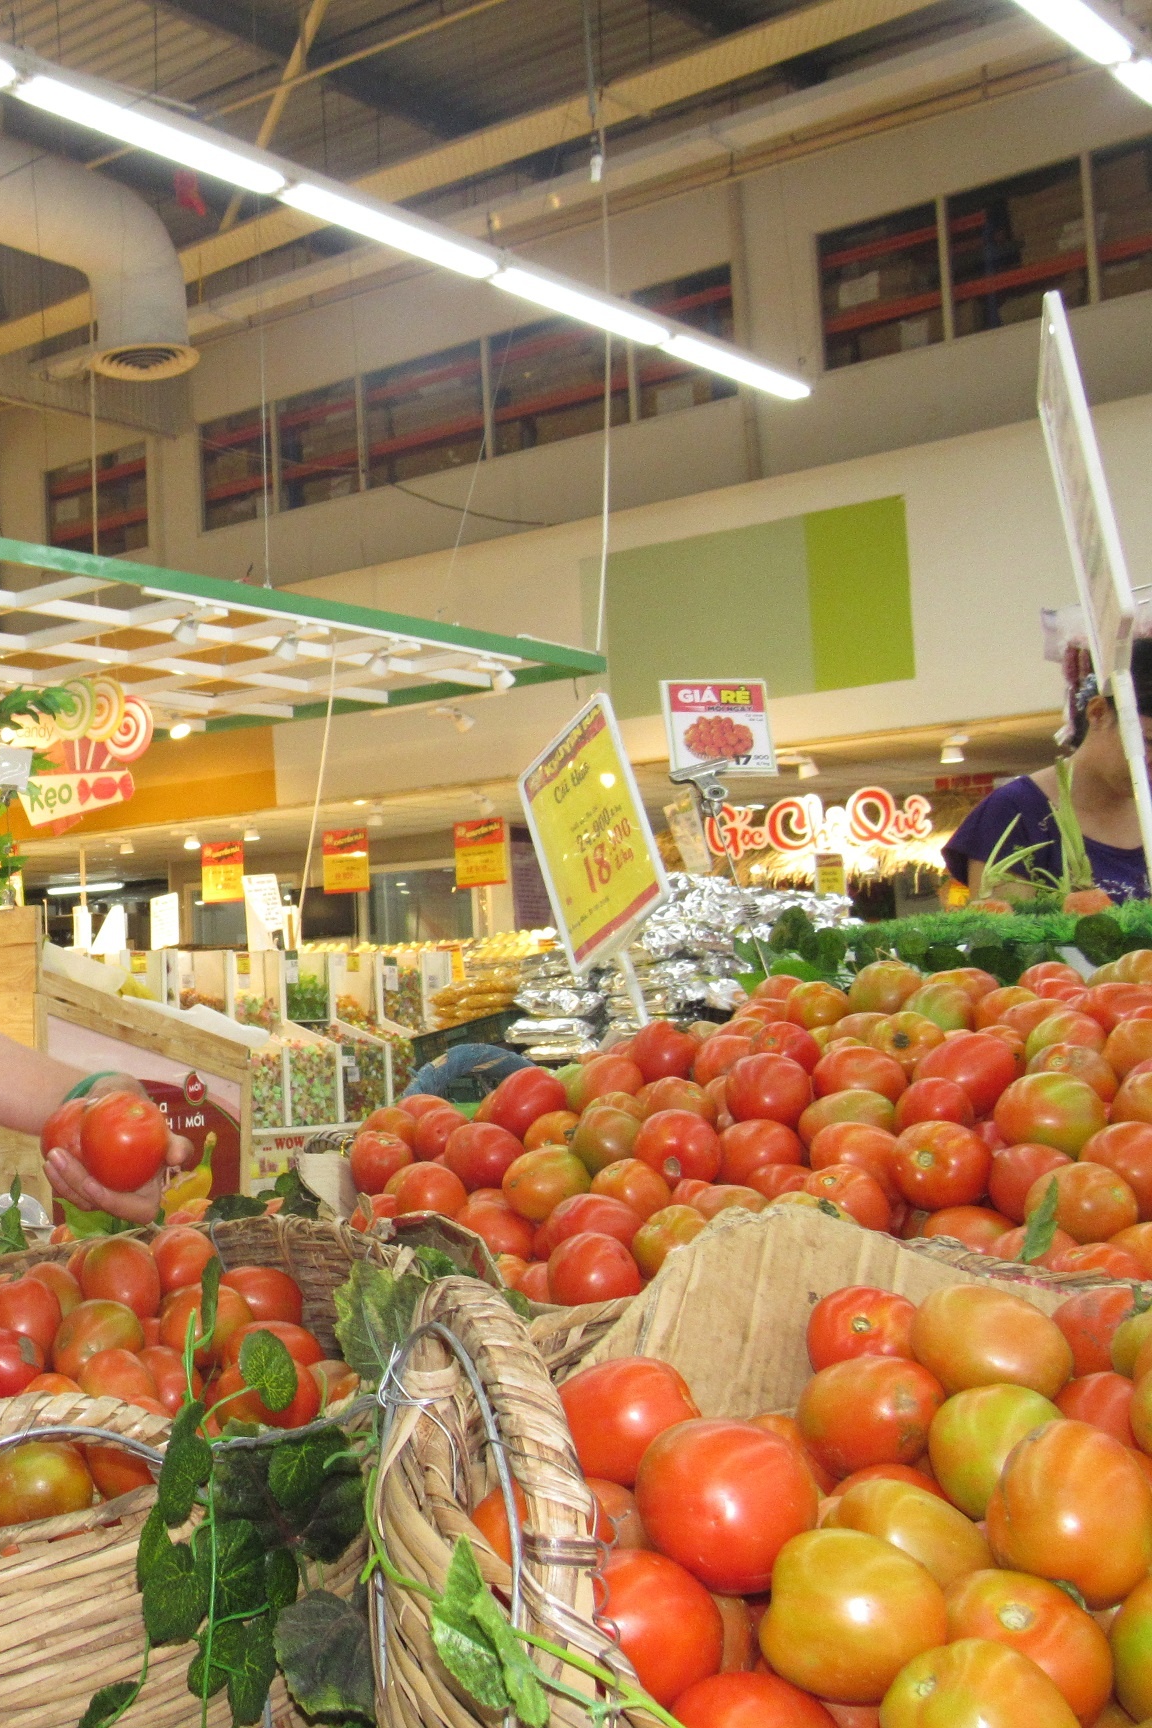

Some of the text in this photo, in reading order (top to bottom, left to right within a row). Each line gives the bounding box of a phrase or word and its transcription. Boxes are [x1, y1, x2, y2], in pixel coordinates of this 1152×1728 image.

[677, 685, 751, 704] GIÁ RẺ
[16, 722, 53, 741] Candy
[733, 754, 752, 765] 17
[28, 783, 72, 814] Kẹo
[847, 788, 931, 846] Quê
[583, 842, 612, 894] 18
[188, 1083, 202, 1092] MỚI
[185, 1111, 205, 1128] MỚI
[275, 1136, 305, 1150] WOW
